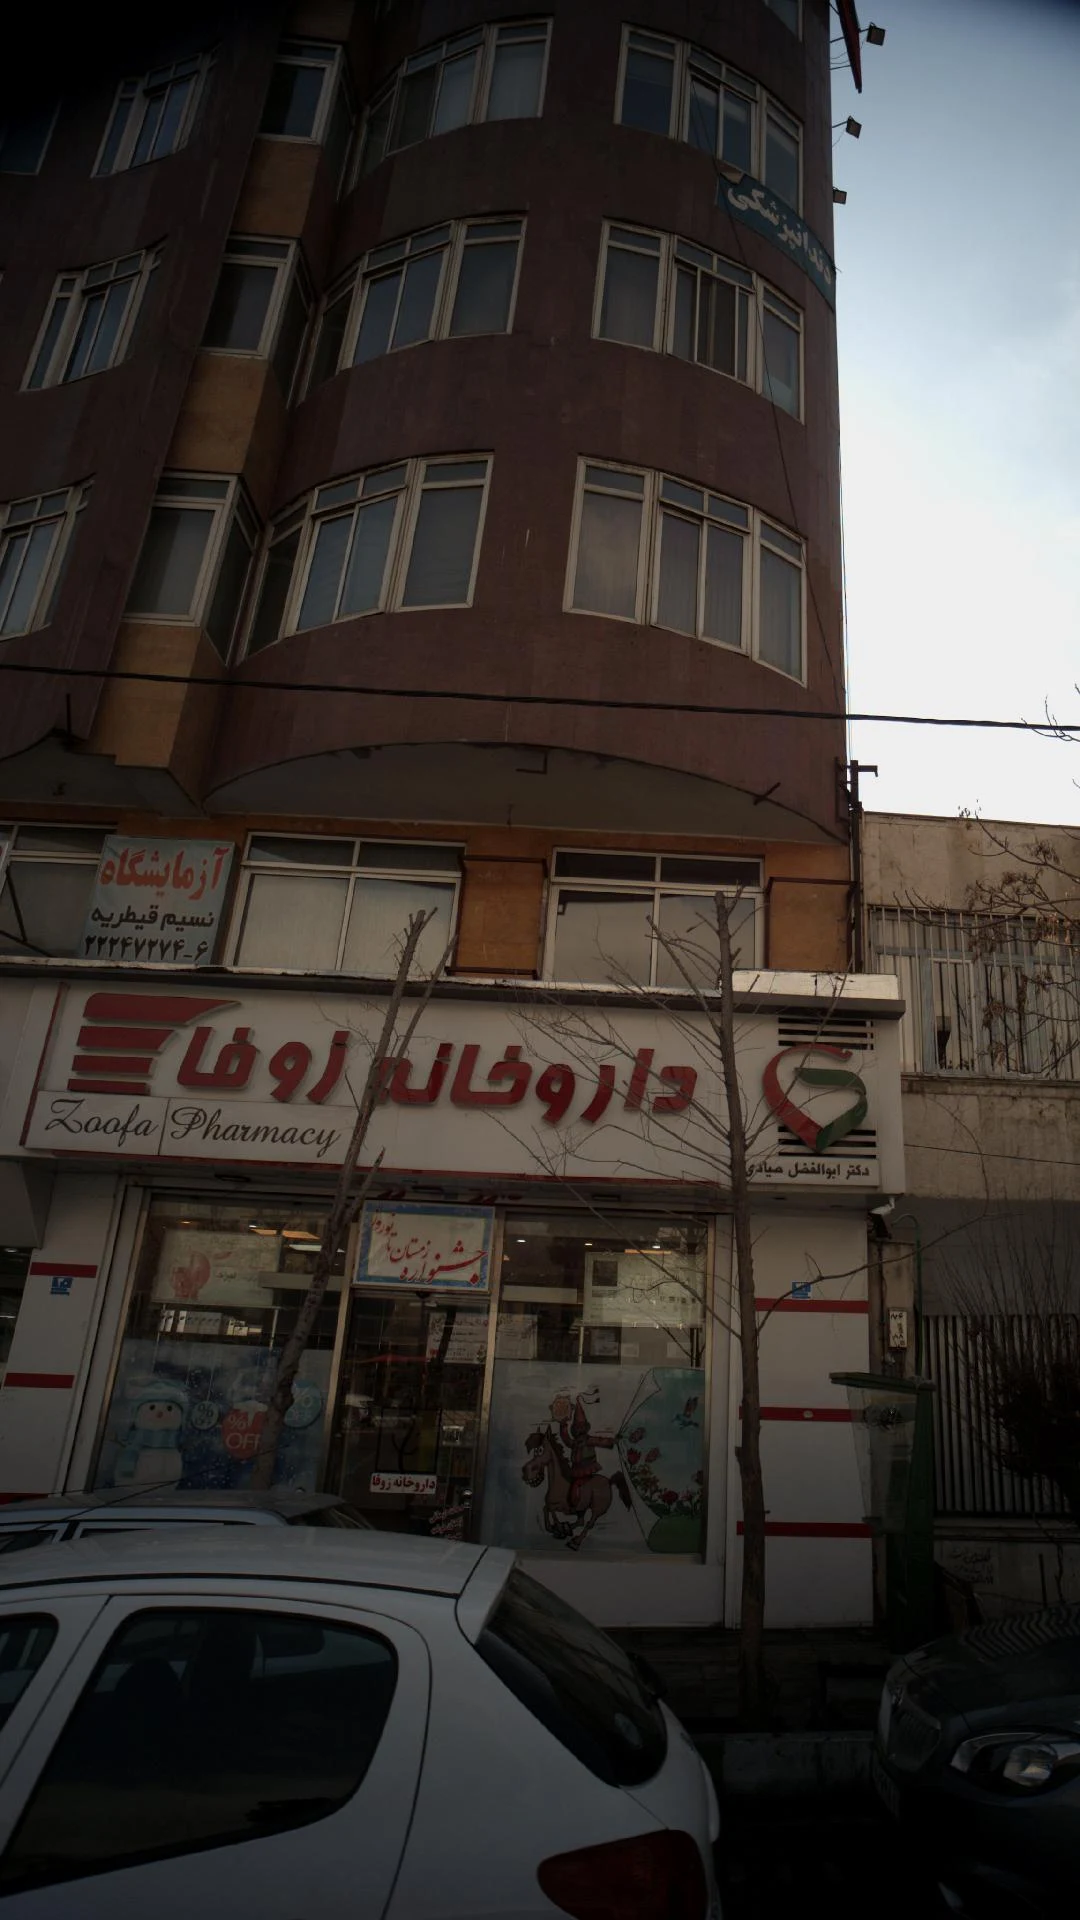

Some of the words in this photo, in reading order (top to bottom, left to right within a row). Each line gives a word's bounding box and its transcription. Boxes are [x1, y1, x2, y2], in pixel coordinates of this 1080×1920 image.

[728, 188, 831, 284] دندانپزشکی
[100, 847, 230, 900] آزمایشگاه
[91, 905, 159, 930] قیطریه
[161, 911, 214, 932] نسیم
[177, 1026, 351, 1105] زوفا
[44, 1098, 158, 1149] Zoofa
[170, 1106, 341, 1157] Pharmacy
[789, 1162, 840, 1179] ابوالفضل
[846, 1164, 870, 1179] دکتر
[390, 1237, 430, 1262] زمستان
[399, 1240, 488, 1285] جشنواره
[371, 1474, 391, 1491] زوفا
[394, 1475, 436, 1492] داروخانه
